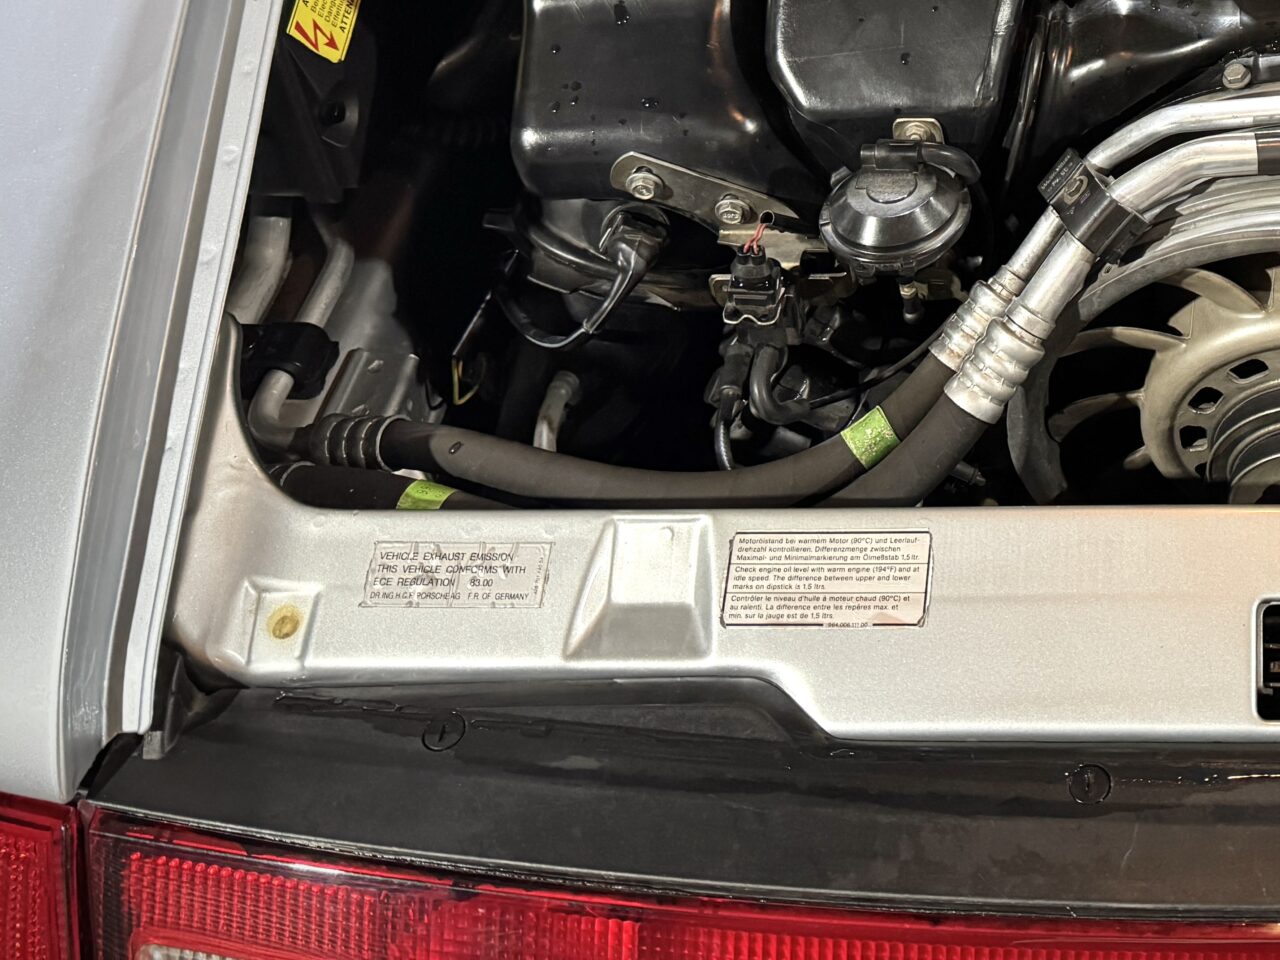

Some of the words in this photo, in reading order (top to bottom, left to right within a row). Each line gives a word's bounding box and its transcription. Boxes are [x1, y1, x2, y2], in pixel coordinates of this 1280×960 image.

[380, 551, 419, 561] VEHICLE
[423, 551, 466, 561] EXHAUST
[469, 552, 515, 561] EMISSION
[784, 554, 848, 562] Minimalmarkierung
[377, 564, 398, 573] THIS
[402, 564, 442, 574] VEHICLE
[501, 565, 527, 574] WITH
[847, 566, 871, 574] engine
[373, 577, 393, 586] ECE
[397, 577, 456, 587] REGULATION
[470, 578, 494, 587] 83.00
[766, 583, 793, 591] dipstick
[481, 592, 492, 600] OF
[494, 592, 529, 600] GERMANY
